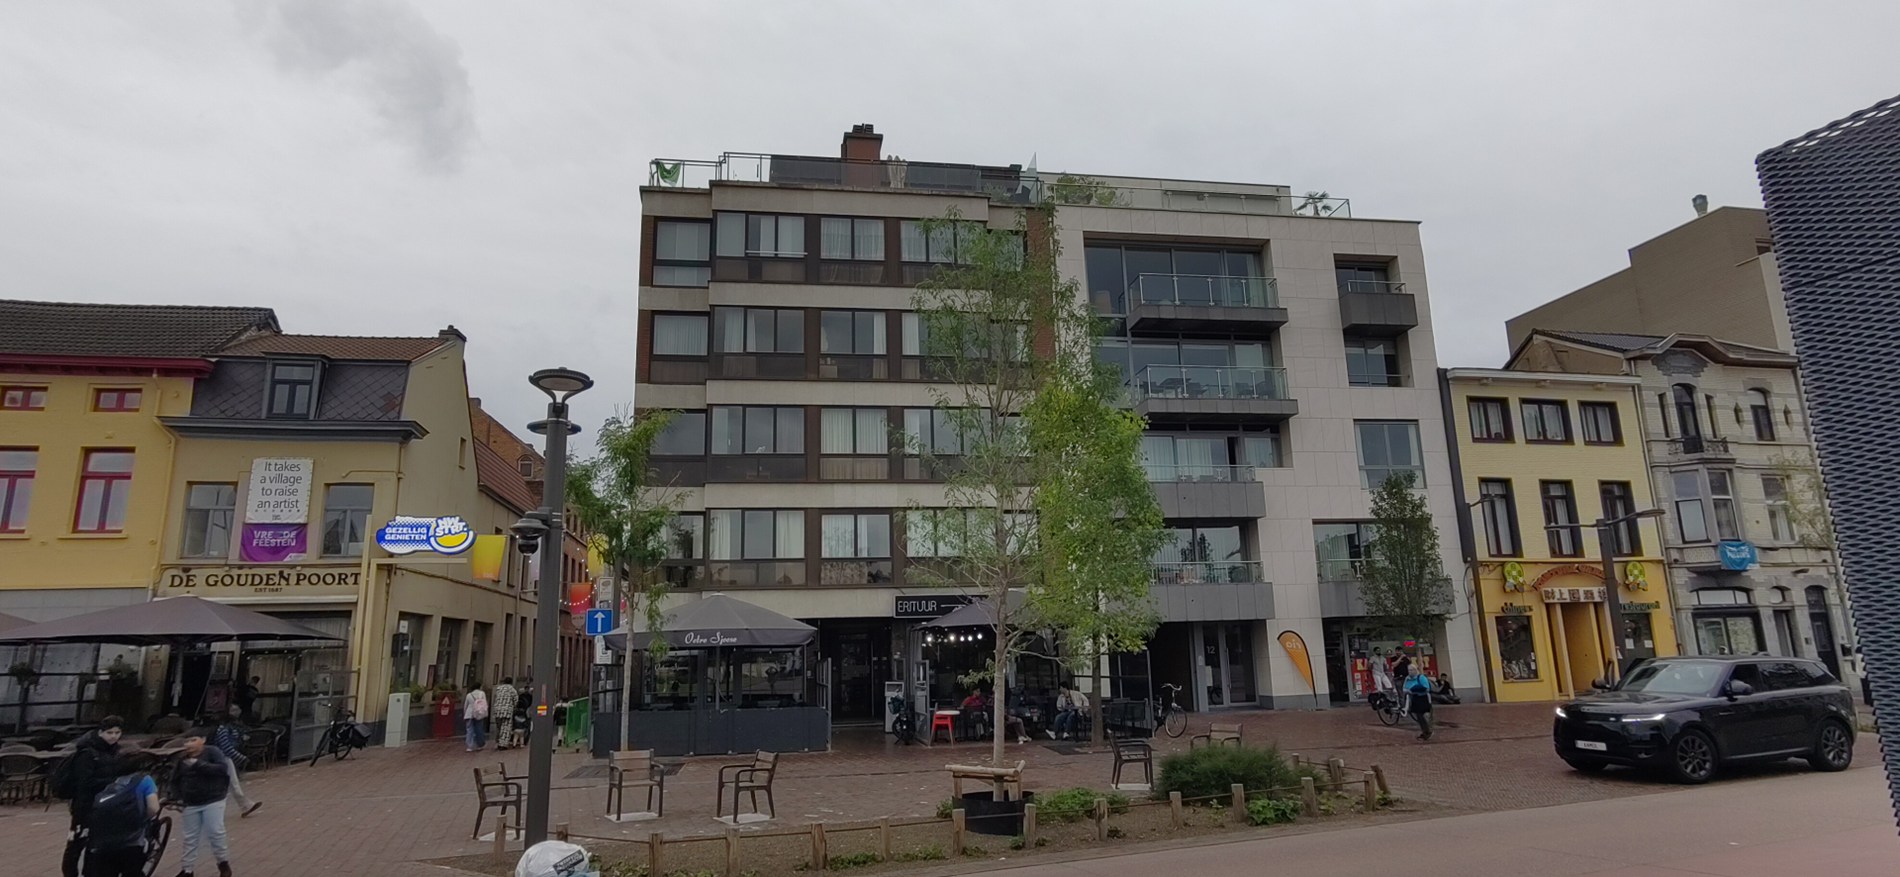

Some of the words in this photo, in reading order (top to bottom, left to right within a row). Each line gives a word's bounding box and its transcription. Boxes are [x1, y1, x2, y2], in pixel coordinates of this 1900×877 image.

[264, 461, 271, 472] It
[274, 461, 301, 472] takes
[260, 475, 266, 484] a
[269, 473, 302, 486] village
[261, 486, 272, 496] to
[274, 486, 298, 496] raise
[257, 500, 270, 508] an
[272, 499, 299, 508] artist
[253, 539, 297, 547] FEESTEN
[169, 574, 196, 588] DE
[205, 573, 291, 587] GOUDEN
[295, 572, 361, 586] POORT
